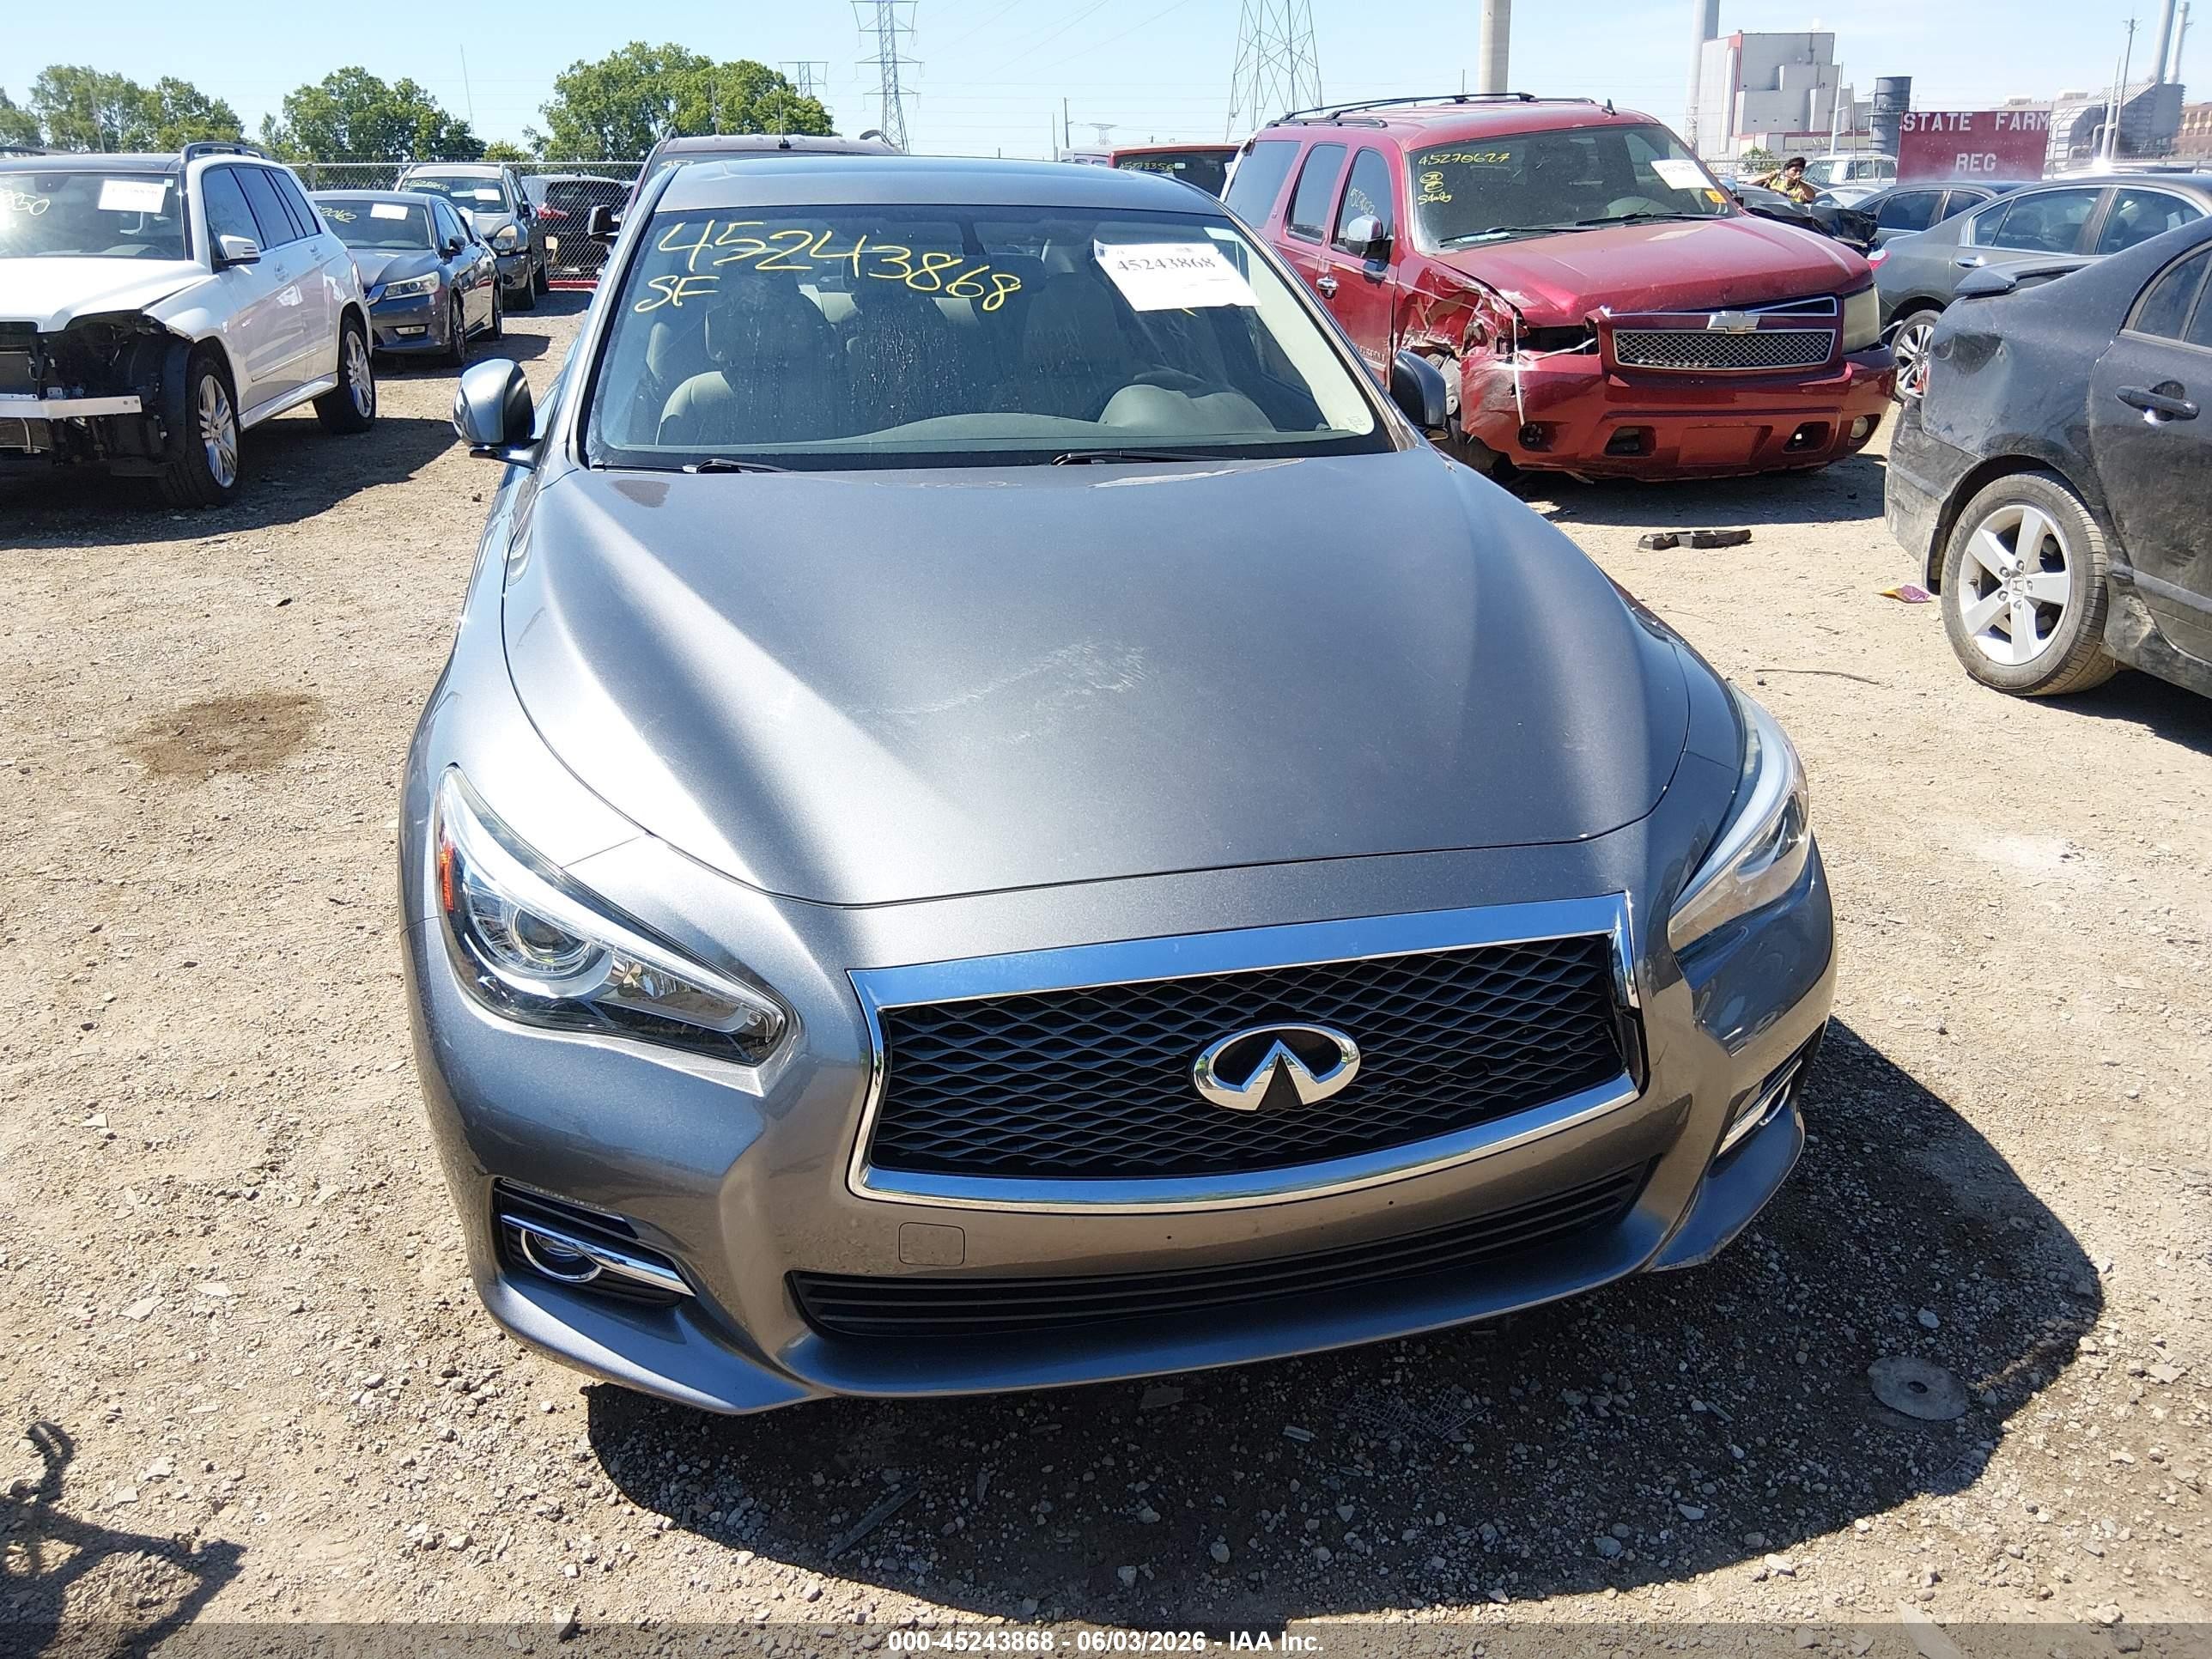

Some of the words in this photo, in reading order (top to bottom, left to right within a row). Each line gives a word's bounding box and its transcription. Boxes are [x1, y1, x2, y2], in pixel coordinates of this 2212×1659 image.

[1903, 112, 1973, 131] STATE
[1995, 112, 2051, 131] FARM
[1955, 153, 1997, 172] REG
[658, 220, 1022, 311] 45243868
[1117, 257, 1216, 271] 45243868
